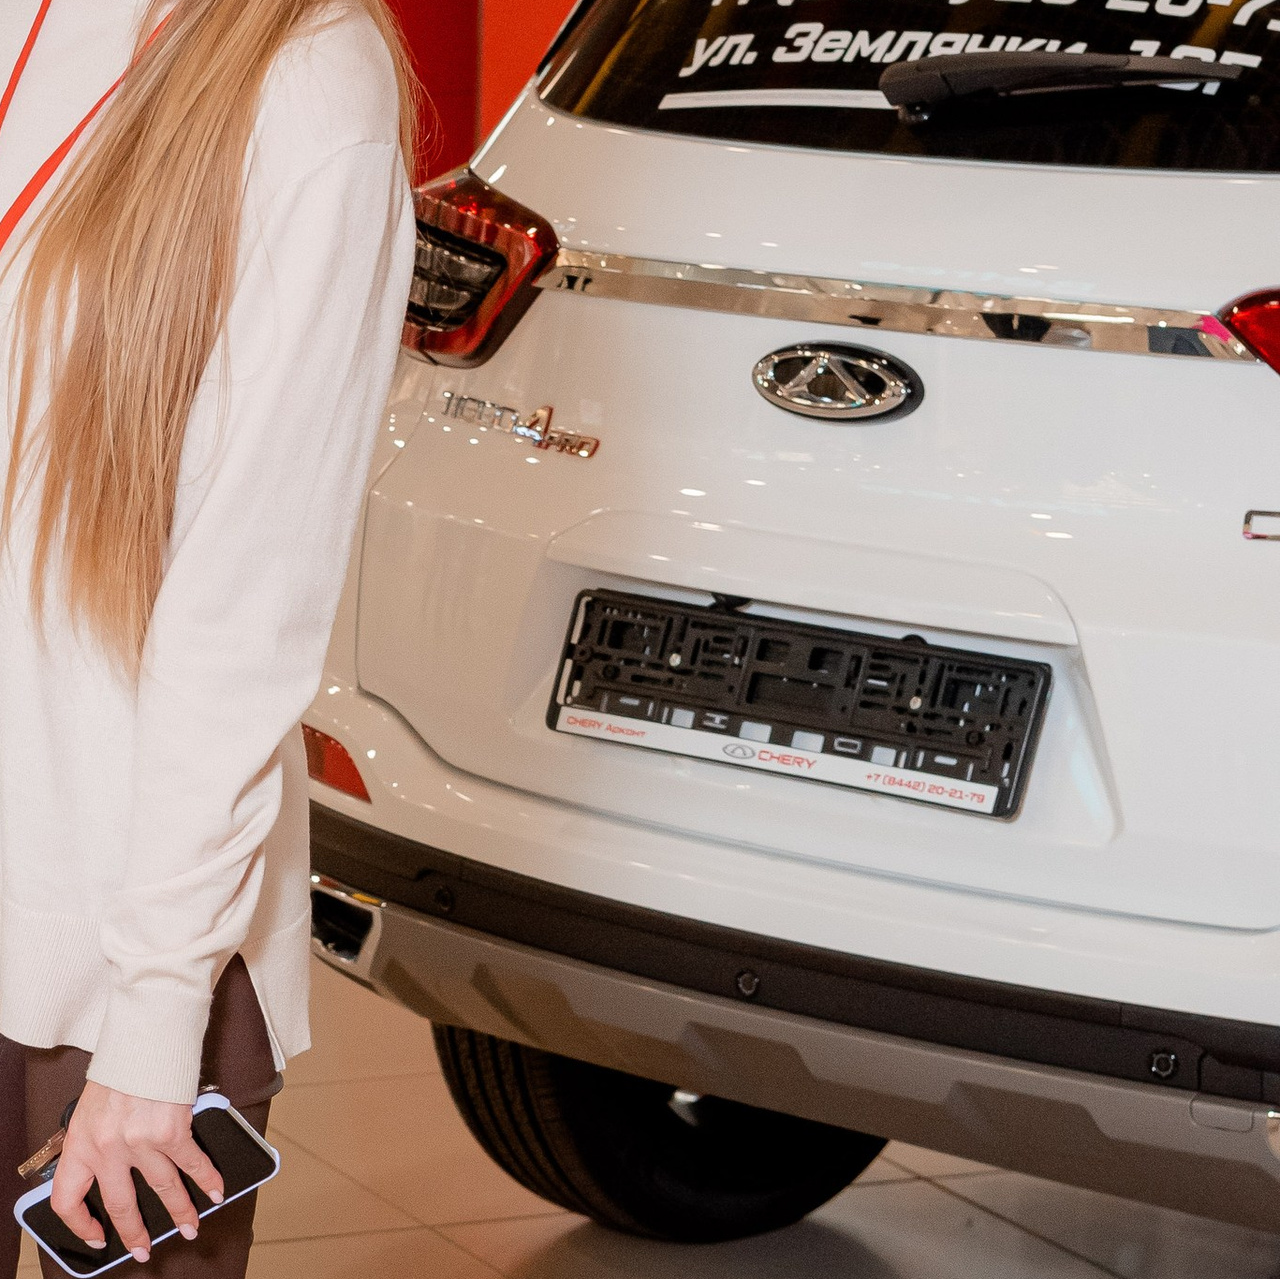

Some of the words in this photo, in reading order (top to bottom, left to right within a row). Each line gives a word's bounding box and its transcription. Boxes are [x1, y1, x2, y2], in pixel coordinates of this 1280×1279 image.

[678, 33, 759, 78] ул.
[566, 715, 604, 729] CHERY
[757, 749, 817, 770] CHERY
[866, 773, 881, 783] +7
[882, 774, 927, 793] (8442)
